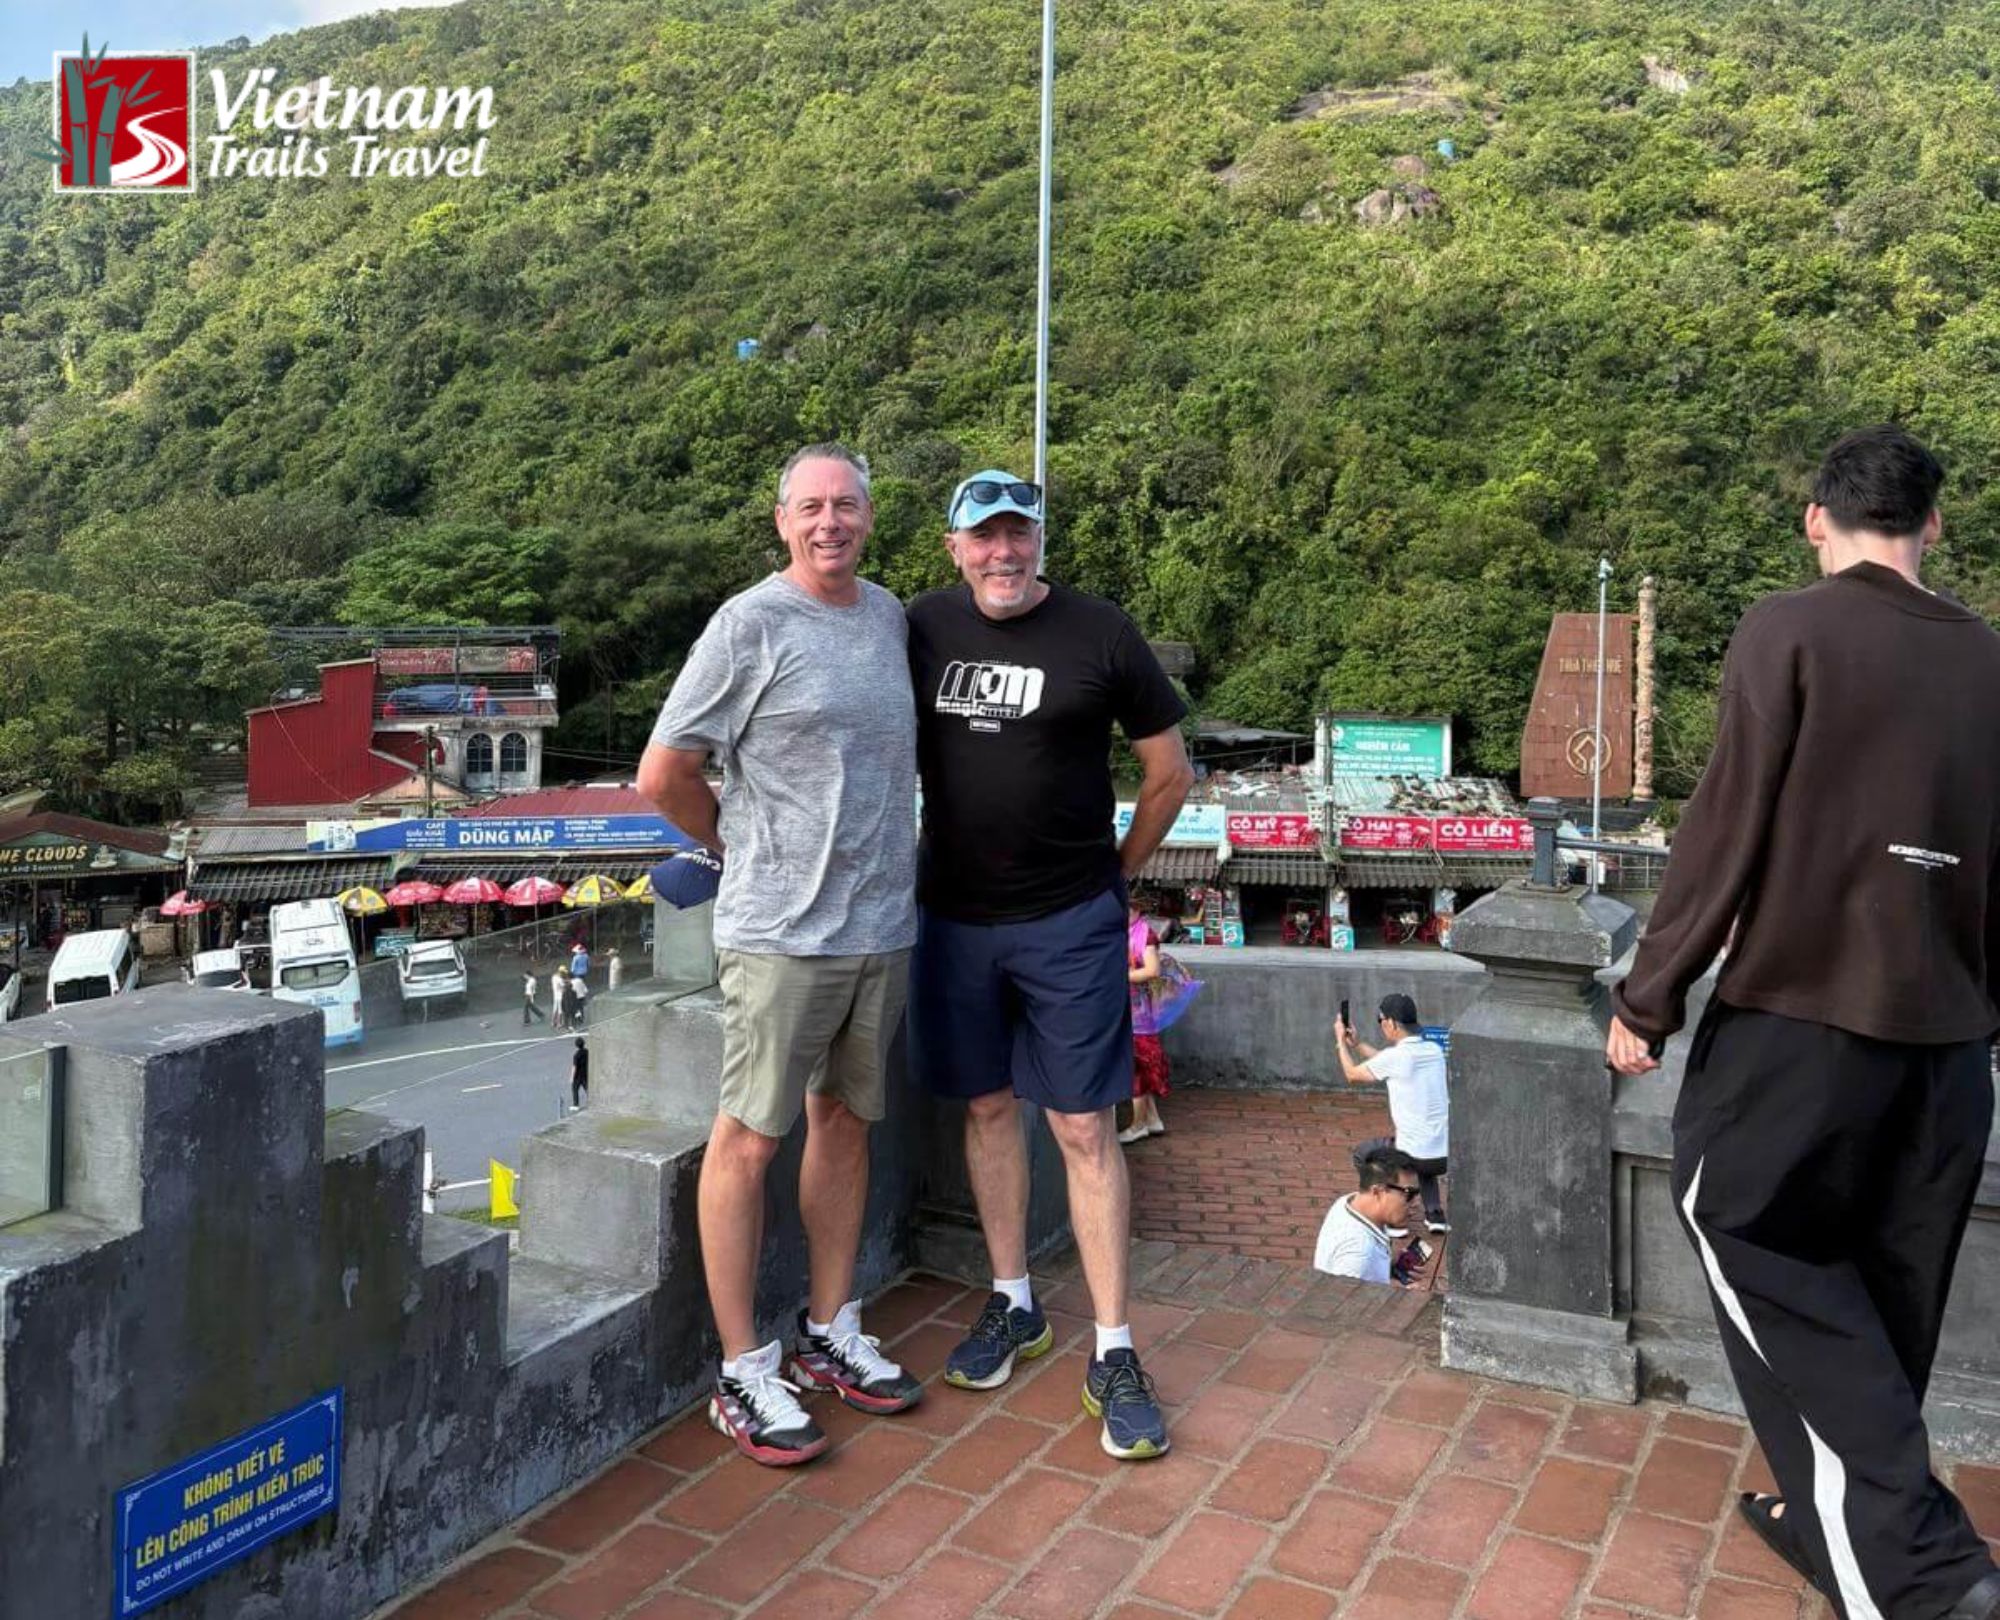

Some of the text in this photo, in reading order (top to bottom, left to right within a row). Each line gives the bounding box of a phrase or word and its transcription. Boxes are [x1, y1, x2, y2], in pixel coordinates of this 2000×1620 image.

[1231, 816, 1251, 830] CÔ
[1441, 821, 1467, 838] CÔ
[459, 828, 510, 844] DŨNG
[25, 845, 88, 863] CLOUDS
[184, 1437, 285, 1510] KHÔNG VIẾT VẼ
[136, 1453, 325, 1570] LÊN CÔNG TRÌNH KIẾN TRÚC
[135, 1482, 325, 1592] DO NOT WRITE AND DRAW ON STRUCTURES
